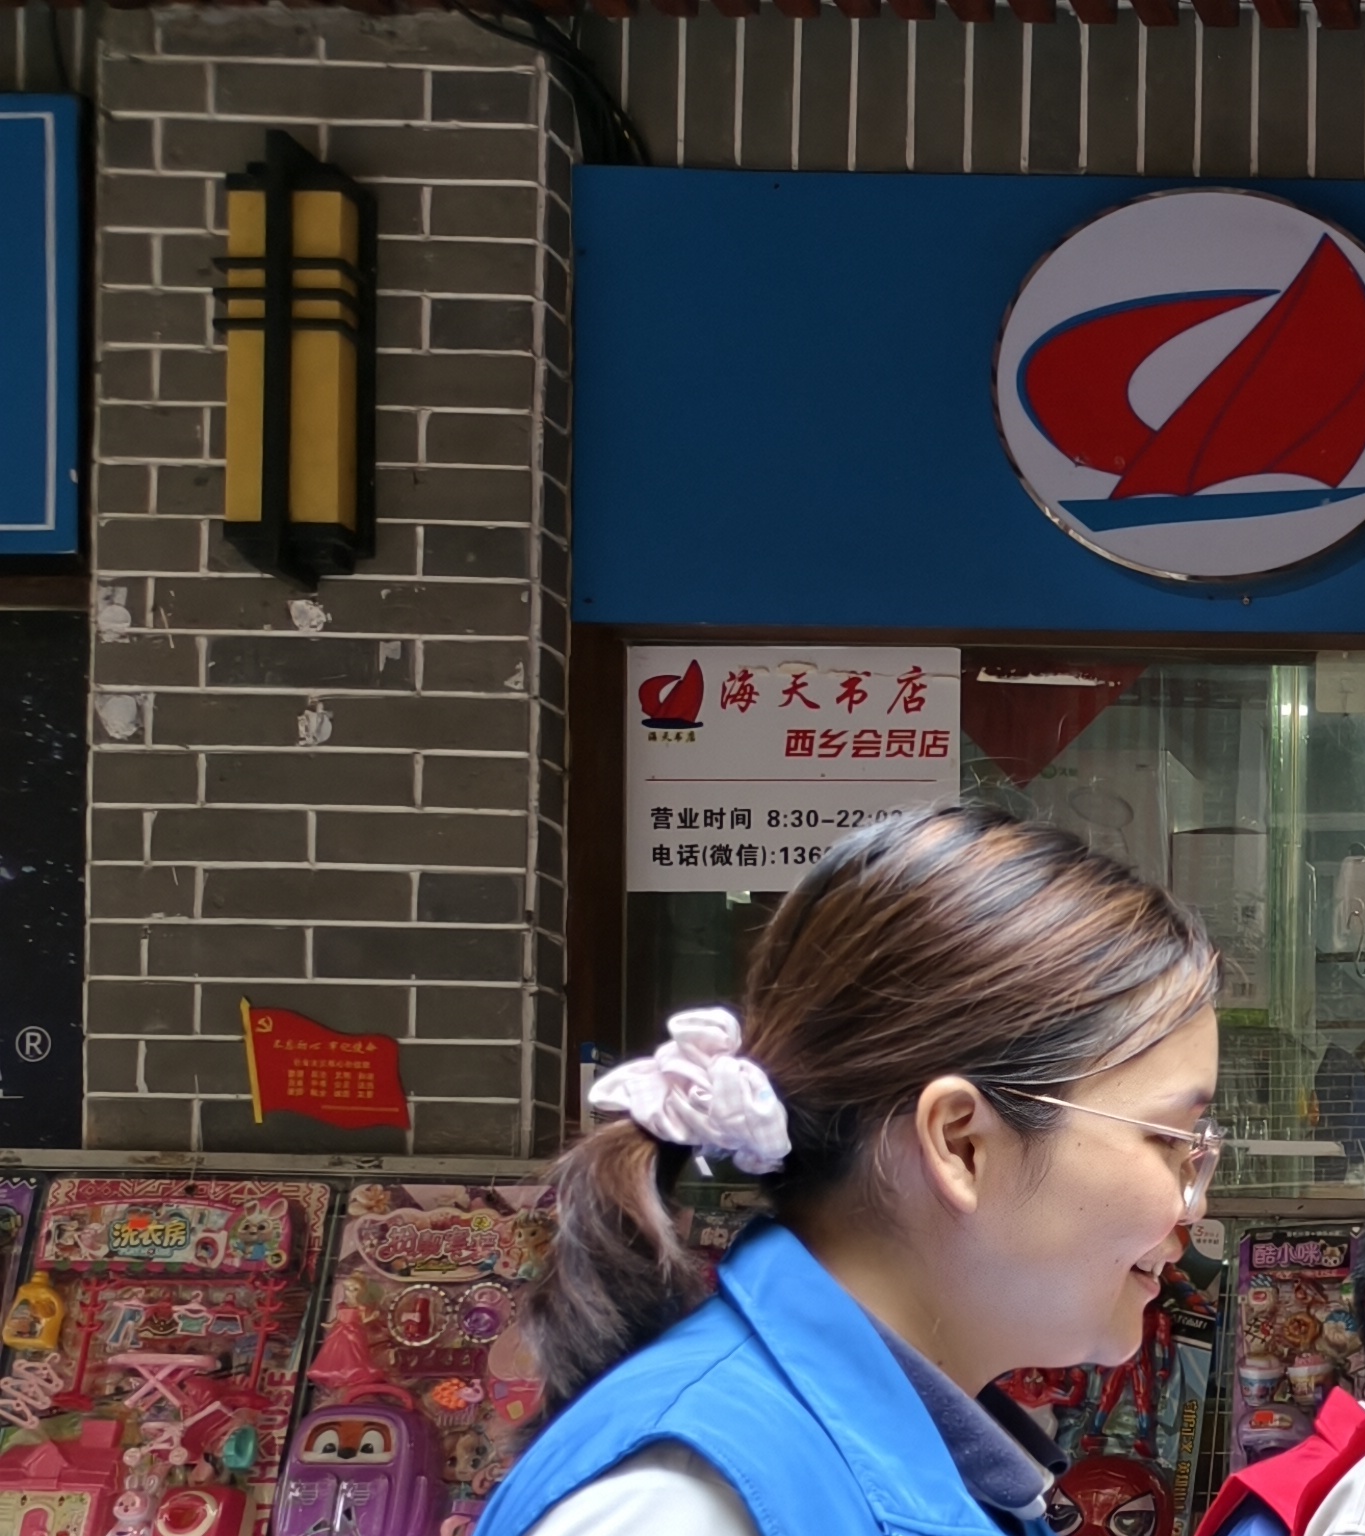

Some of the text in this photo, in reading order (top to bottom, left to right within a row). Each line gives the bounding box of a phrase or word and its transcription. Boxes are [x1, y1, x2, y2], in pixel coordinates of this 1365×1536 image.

[720, 667, 929, 715] 海天书店
[785, 729, 951, 758] 西乡会员店
[650, 808, 753, 831] 营业时间
